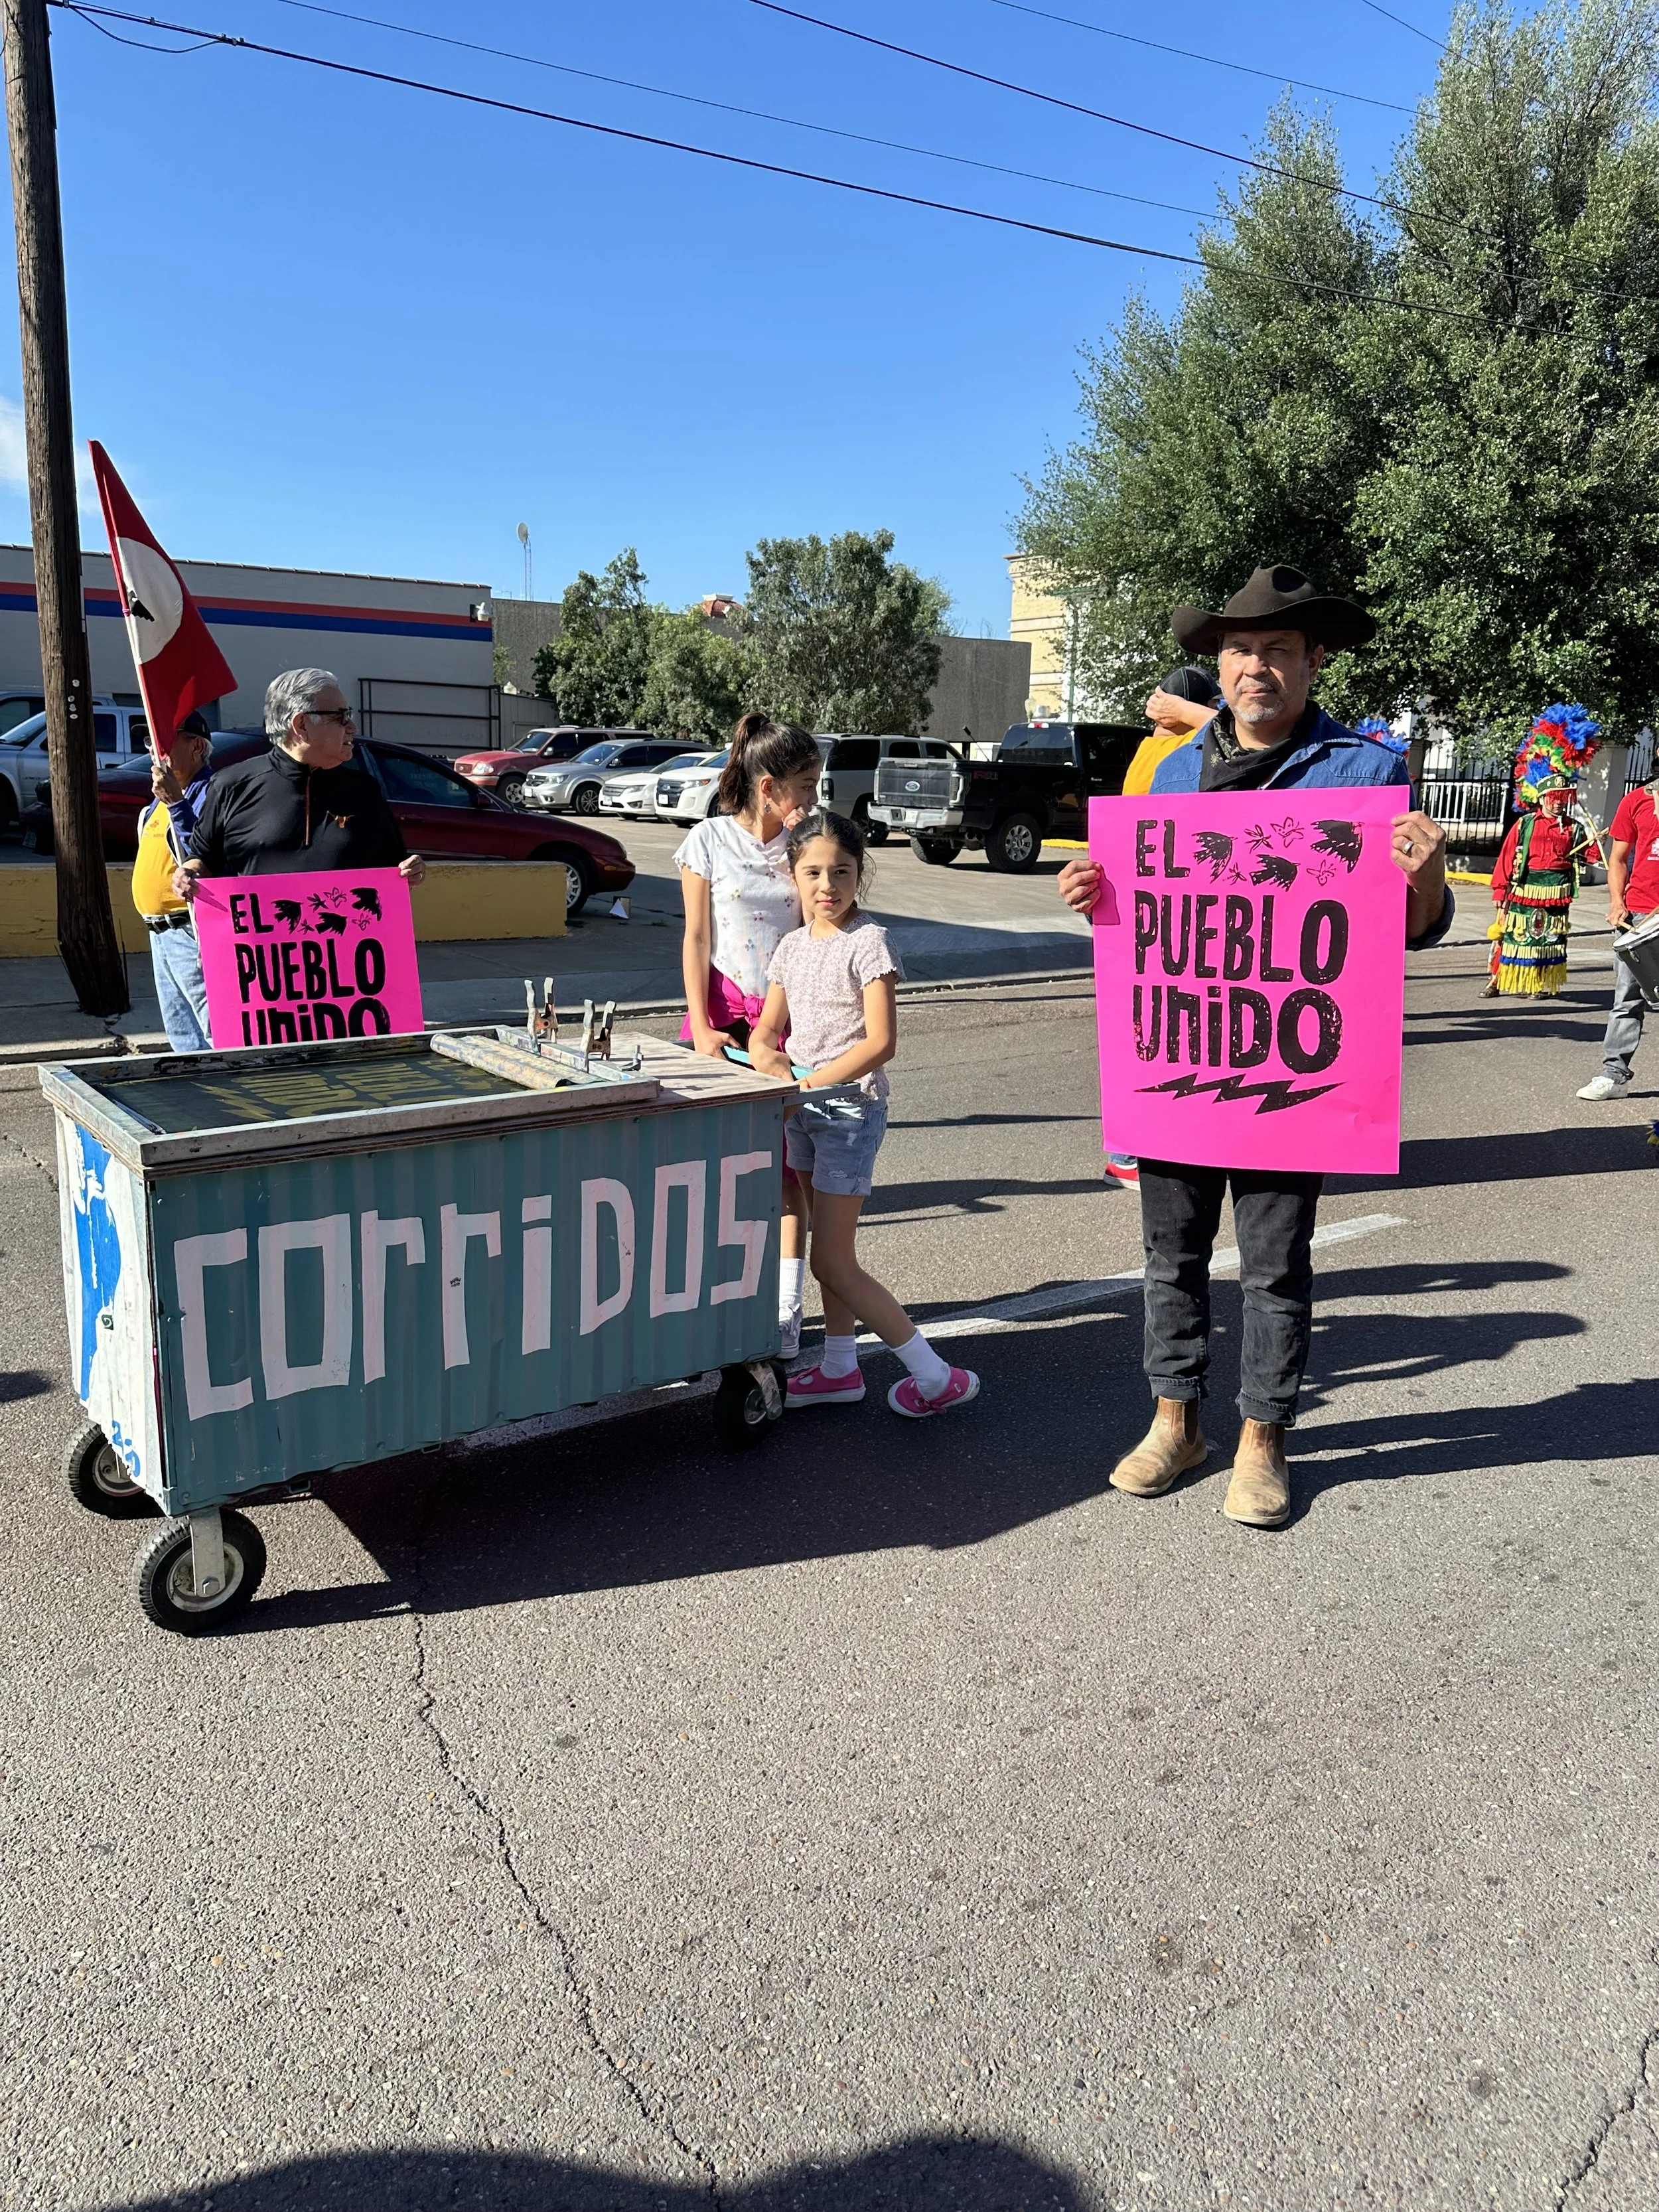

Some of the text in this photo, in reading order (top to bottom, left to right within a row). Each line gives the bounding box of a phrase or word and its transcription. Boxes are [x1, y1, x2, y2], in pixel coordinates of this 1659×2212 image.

[1137, 819, 1190, 878] EL
[230, 893, 274, 934] EL
[1134, 890, 1349, 986] PUEBLO
[234, 938, 386, 1003] PUEBLO
